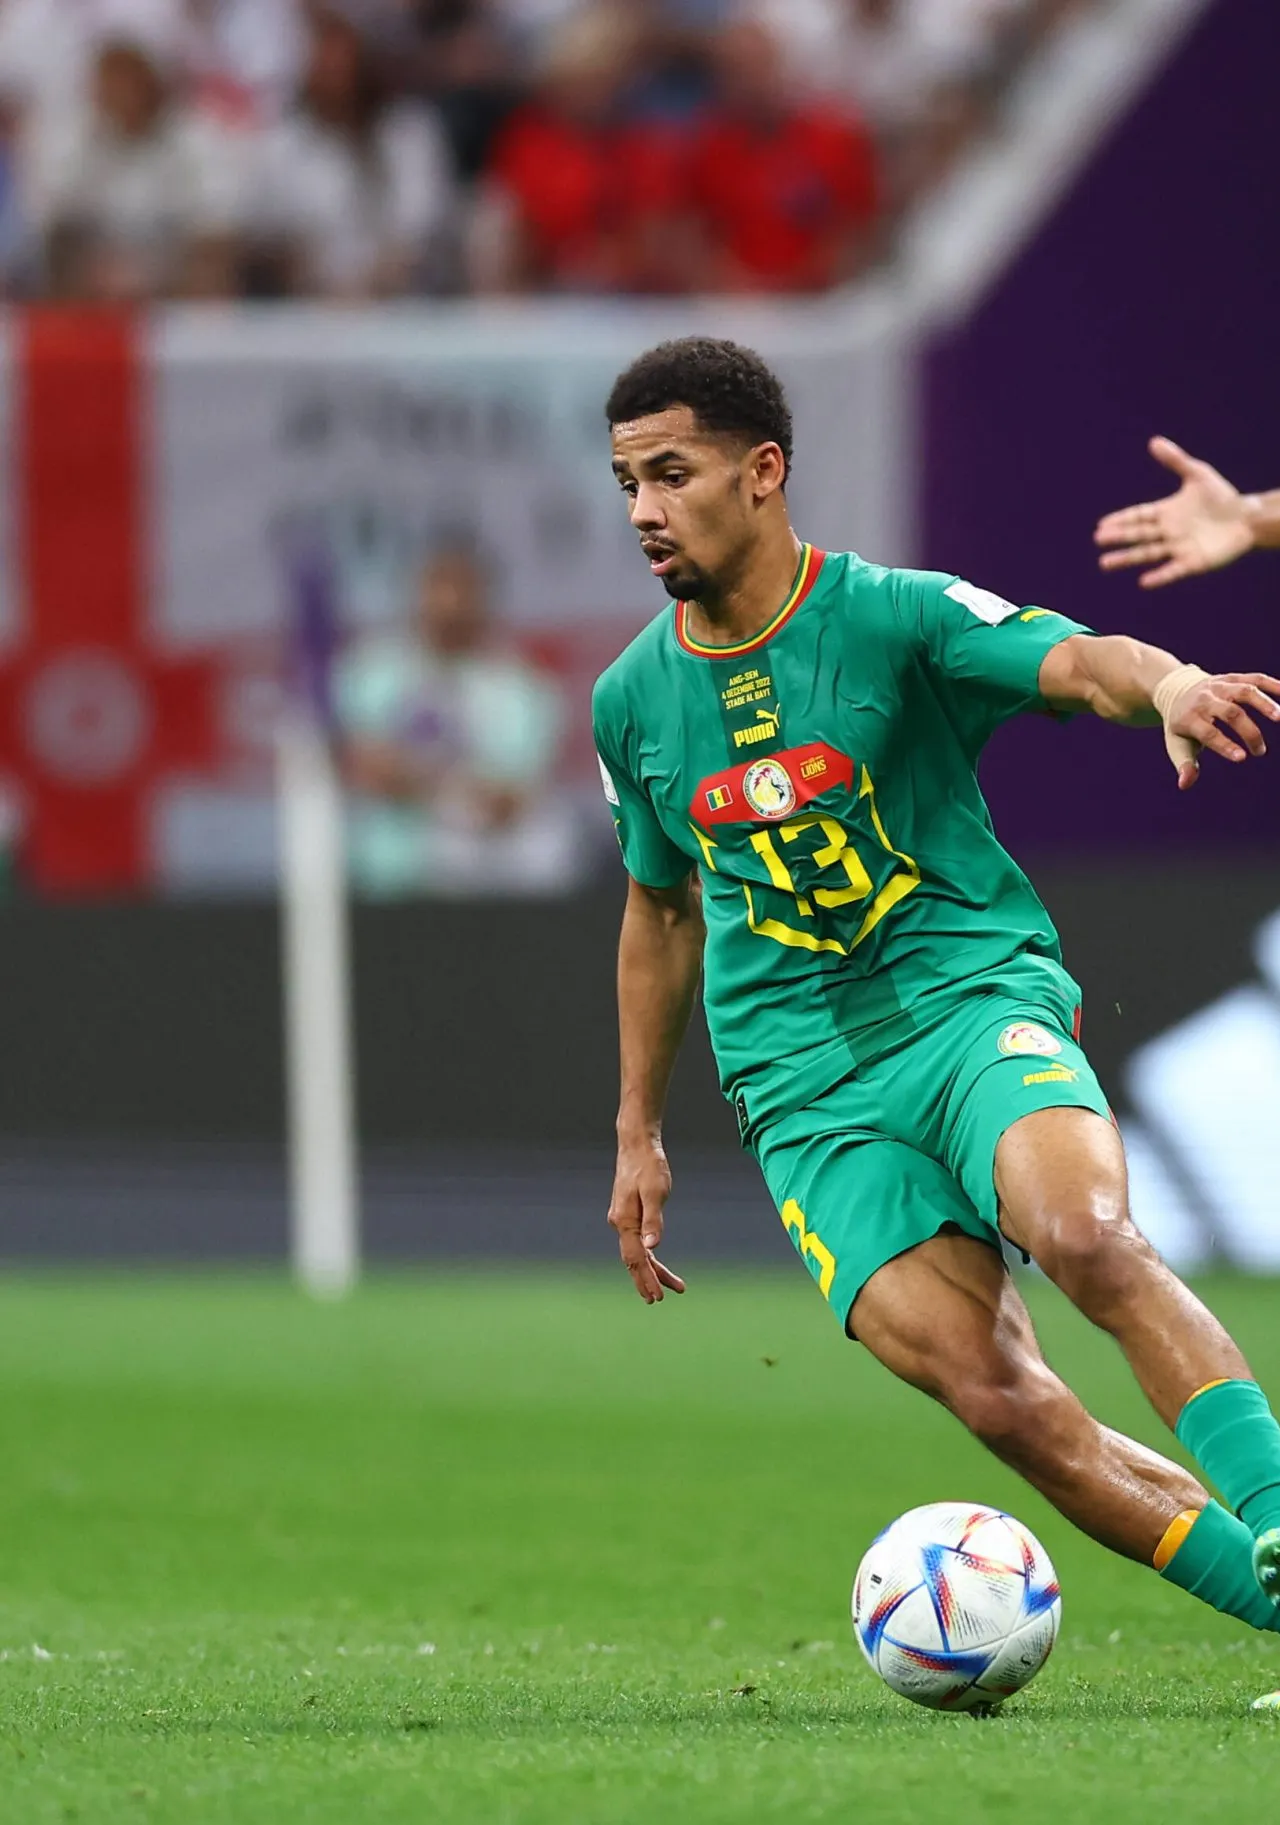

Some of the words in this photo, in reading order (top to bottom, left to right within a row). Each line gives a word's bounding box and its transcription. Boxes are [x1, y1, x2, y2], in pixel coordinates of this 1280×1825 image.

[729, 669, 759, 687] ANG-SEN
[755, 676, 771, 689] 2022
[725, 695, 746, 710] STADE
[746, 692, 755, 702] AL
[754, 687, 771, 700] BAYT
[733, 721, 776, 748] PUMA
[800, 759, 827, 779] LIONS
[749, 812, 874, 917] 13
[1023, 1069, 1074, 1086] PUMA
